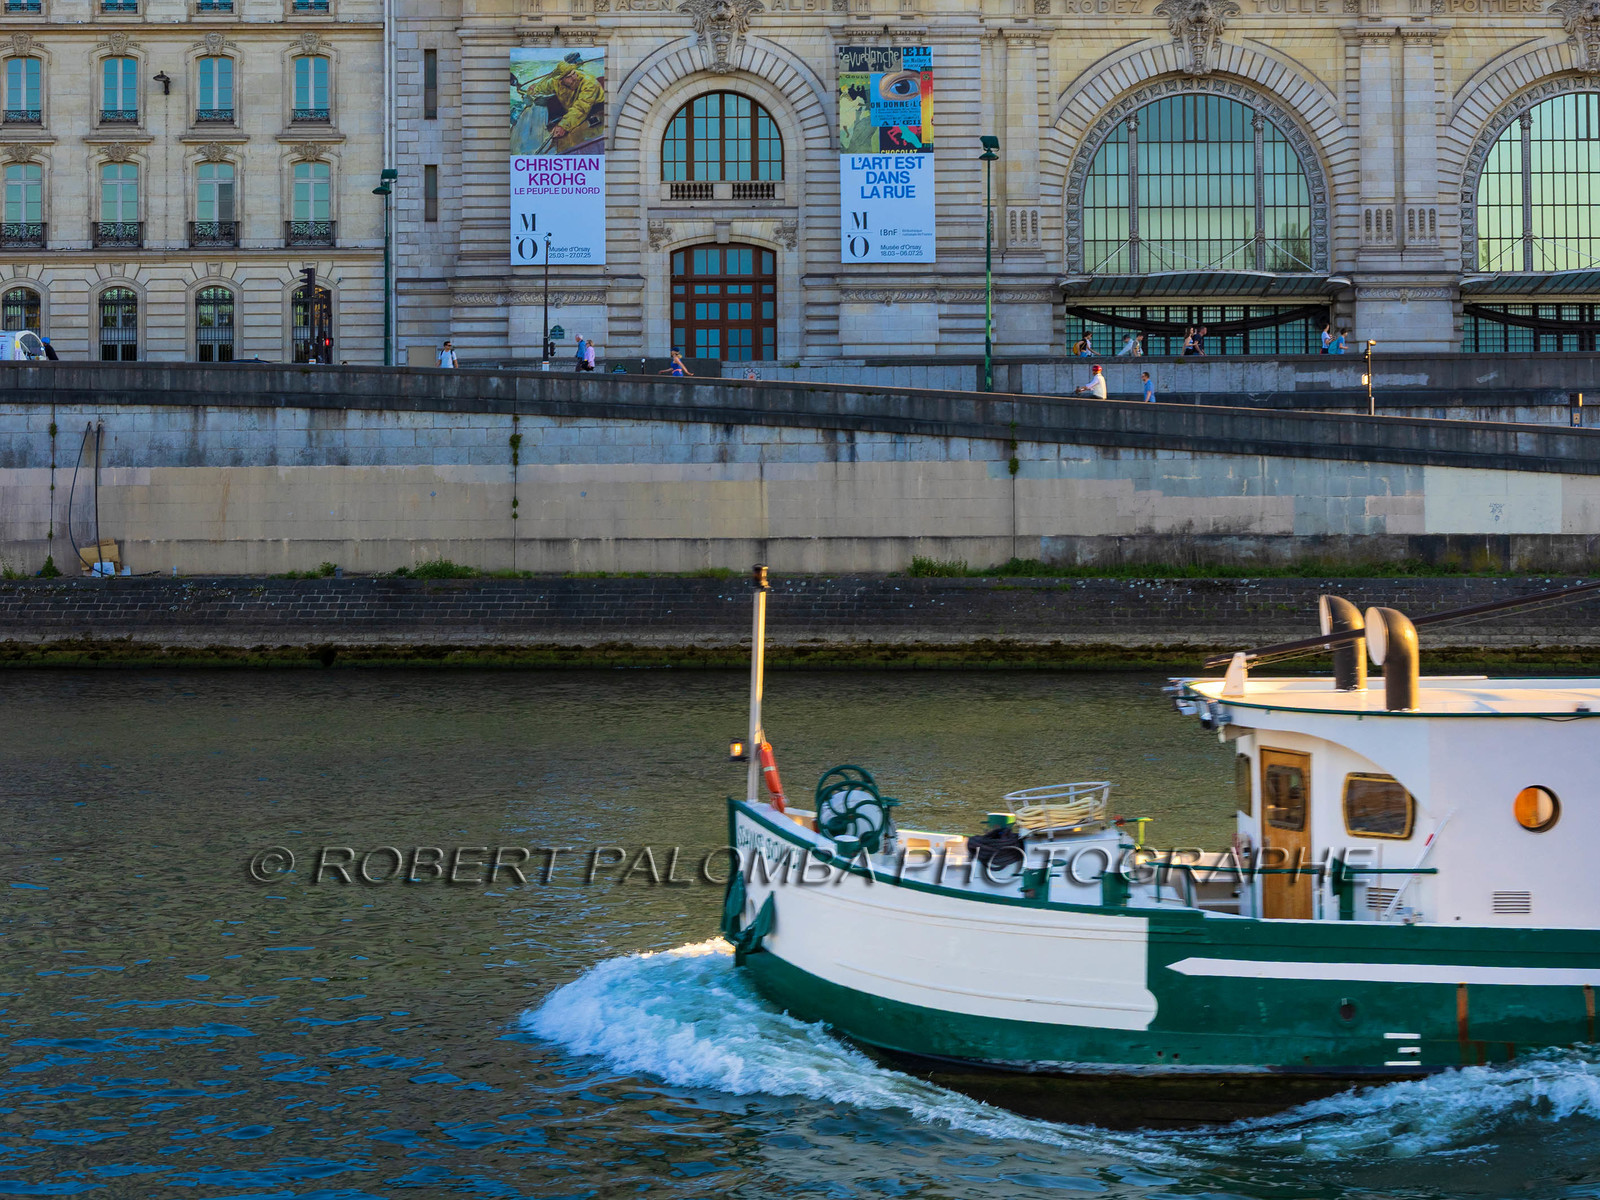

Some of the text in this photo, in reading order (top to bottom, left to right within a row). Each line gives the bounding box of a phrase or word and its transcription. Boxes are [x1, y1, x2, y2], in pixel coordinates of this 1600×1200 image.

[1064, 0, 1144, 14] RODEZ
[514, 158, 600, 172] CHRISTIAN
[851, 156, 925, 170] L'ART EST
[528, 173, 586, 186] KROHG
[866, 172, 910, 184] DANS
[860, 186, 916, 198] LA RUE
[520, 213, 536, 231] M
[851, 212, 869, 230] M
